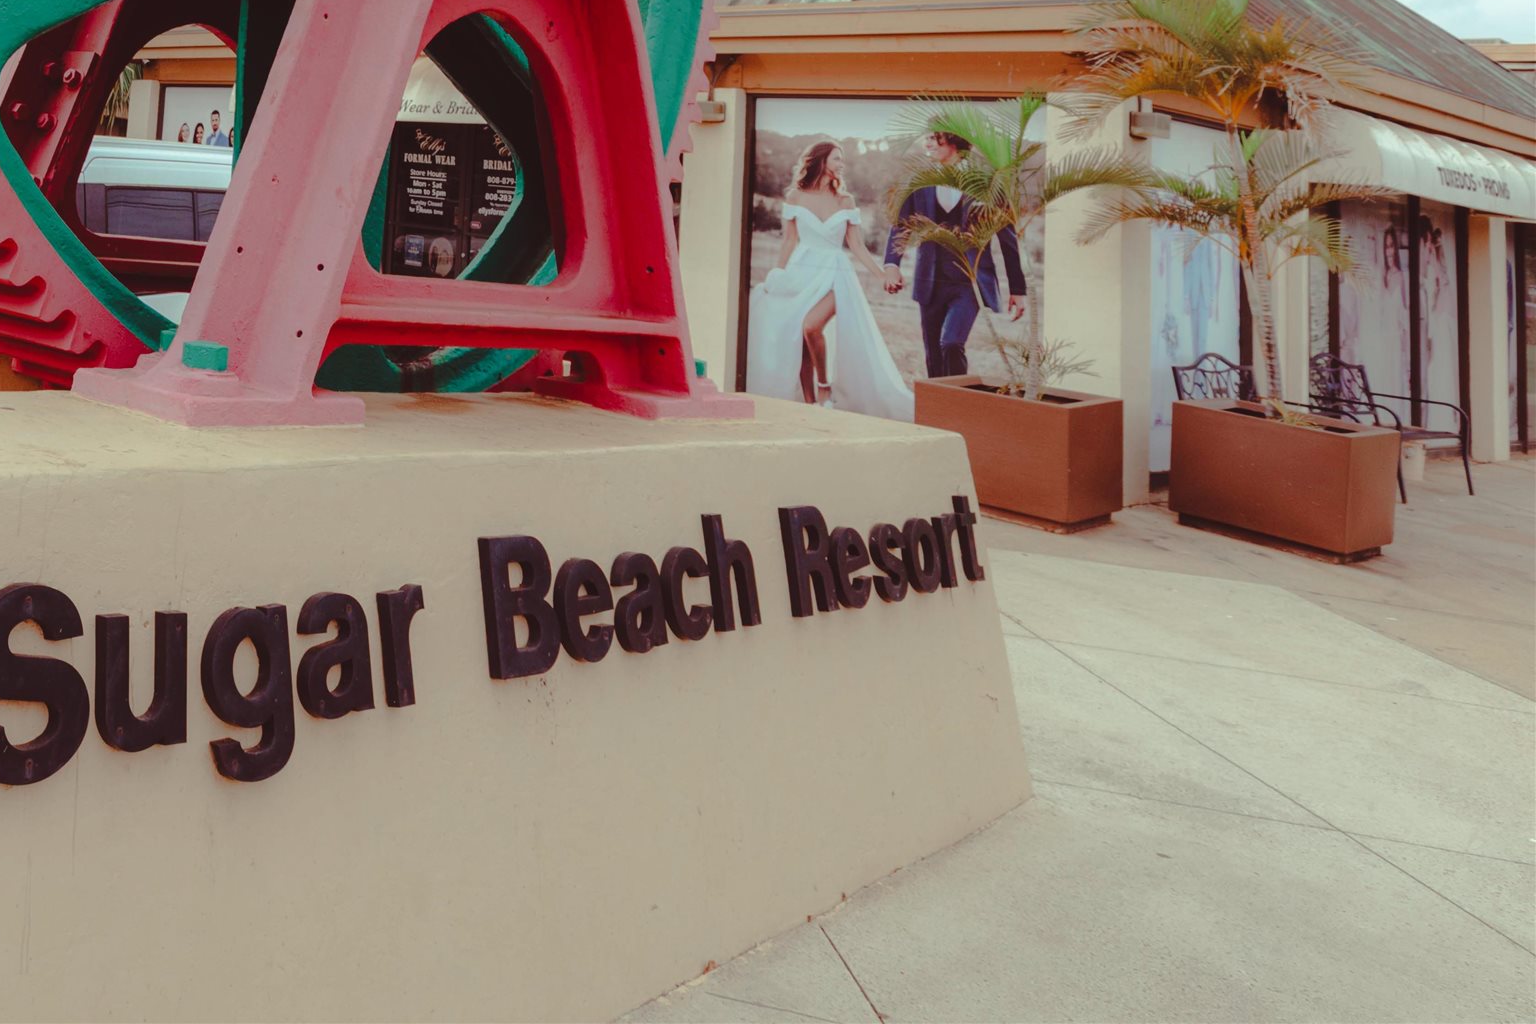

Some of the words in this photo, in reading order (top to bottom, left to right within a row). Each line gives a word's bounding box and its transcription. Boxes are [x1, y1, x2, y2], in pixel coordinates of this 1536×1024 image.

[401, 99, 430, 113] Wear
[432, 101, 443, 114] &
[404, 153, 432, 164] FORMAL
[435, 154, 456, 166] WEAR
[483, 159, 512, 171] BRIDAL
[410, 168, 426, 176] Store
[427, 170, 447, 178] Hours:
[413, 179, 426, 187] Mon
[432, 181, 442, 189] Sat
[1436, 166, 1478, 192] TUXEDOS
[1481, 176, 1511, 200] PROMS
[431, 188, 447, 198] 5pm
[477, 513, 762, 682] Beach
[777, 494, 986, 619] Resort
